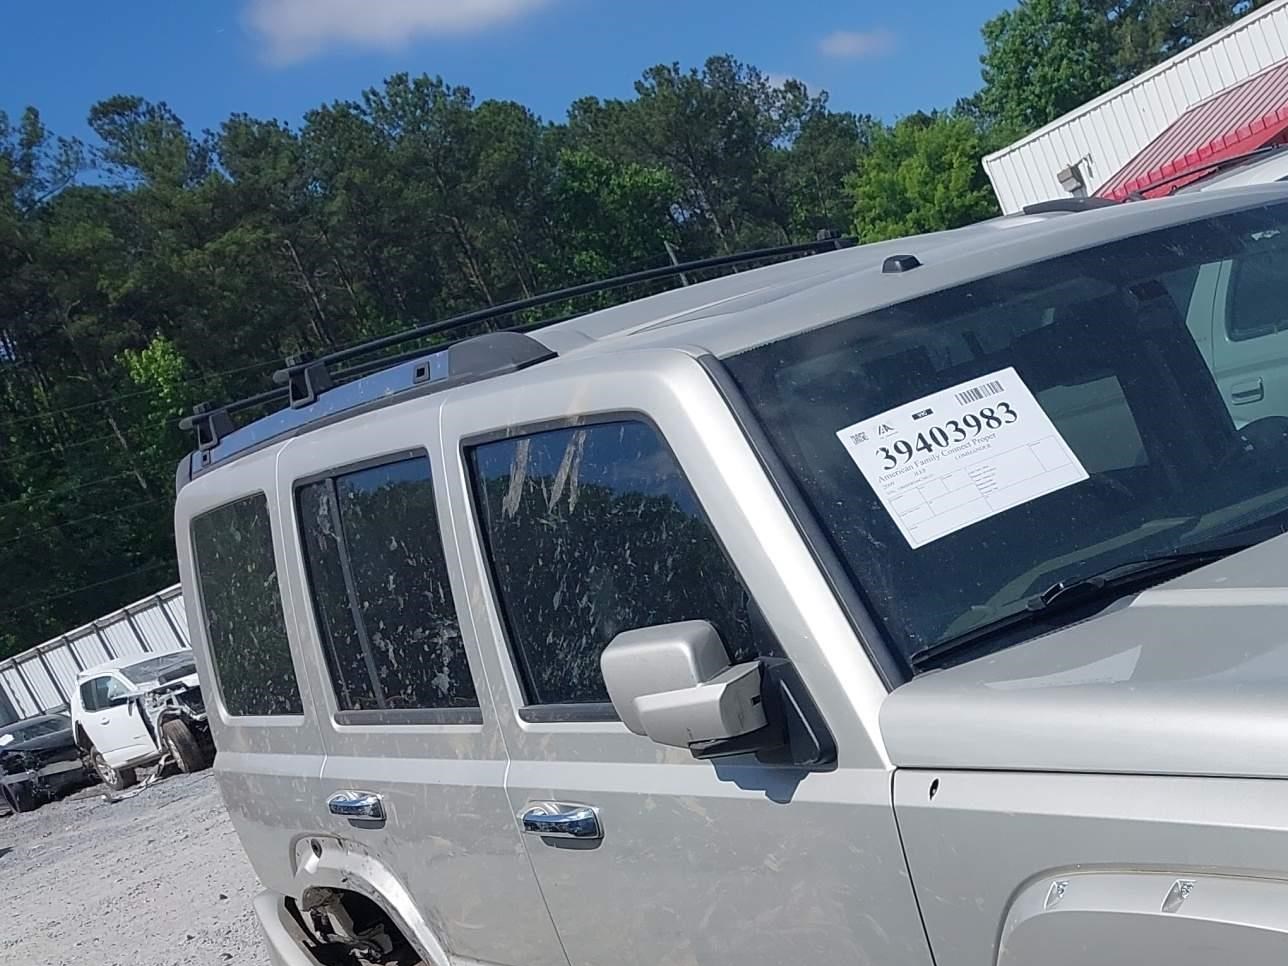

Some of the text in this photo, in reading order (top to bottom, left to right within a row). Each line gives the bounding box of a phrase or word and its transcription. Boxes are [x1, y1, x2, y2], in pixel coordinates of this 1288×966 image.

[875, 401, 1018, 470] 39403983
[878, 432, 997, 483] American Family Connect Proper
